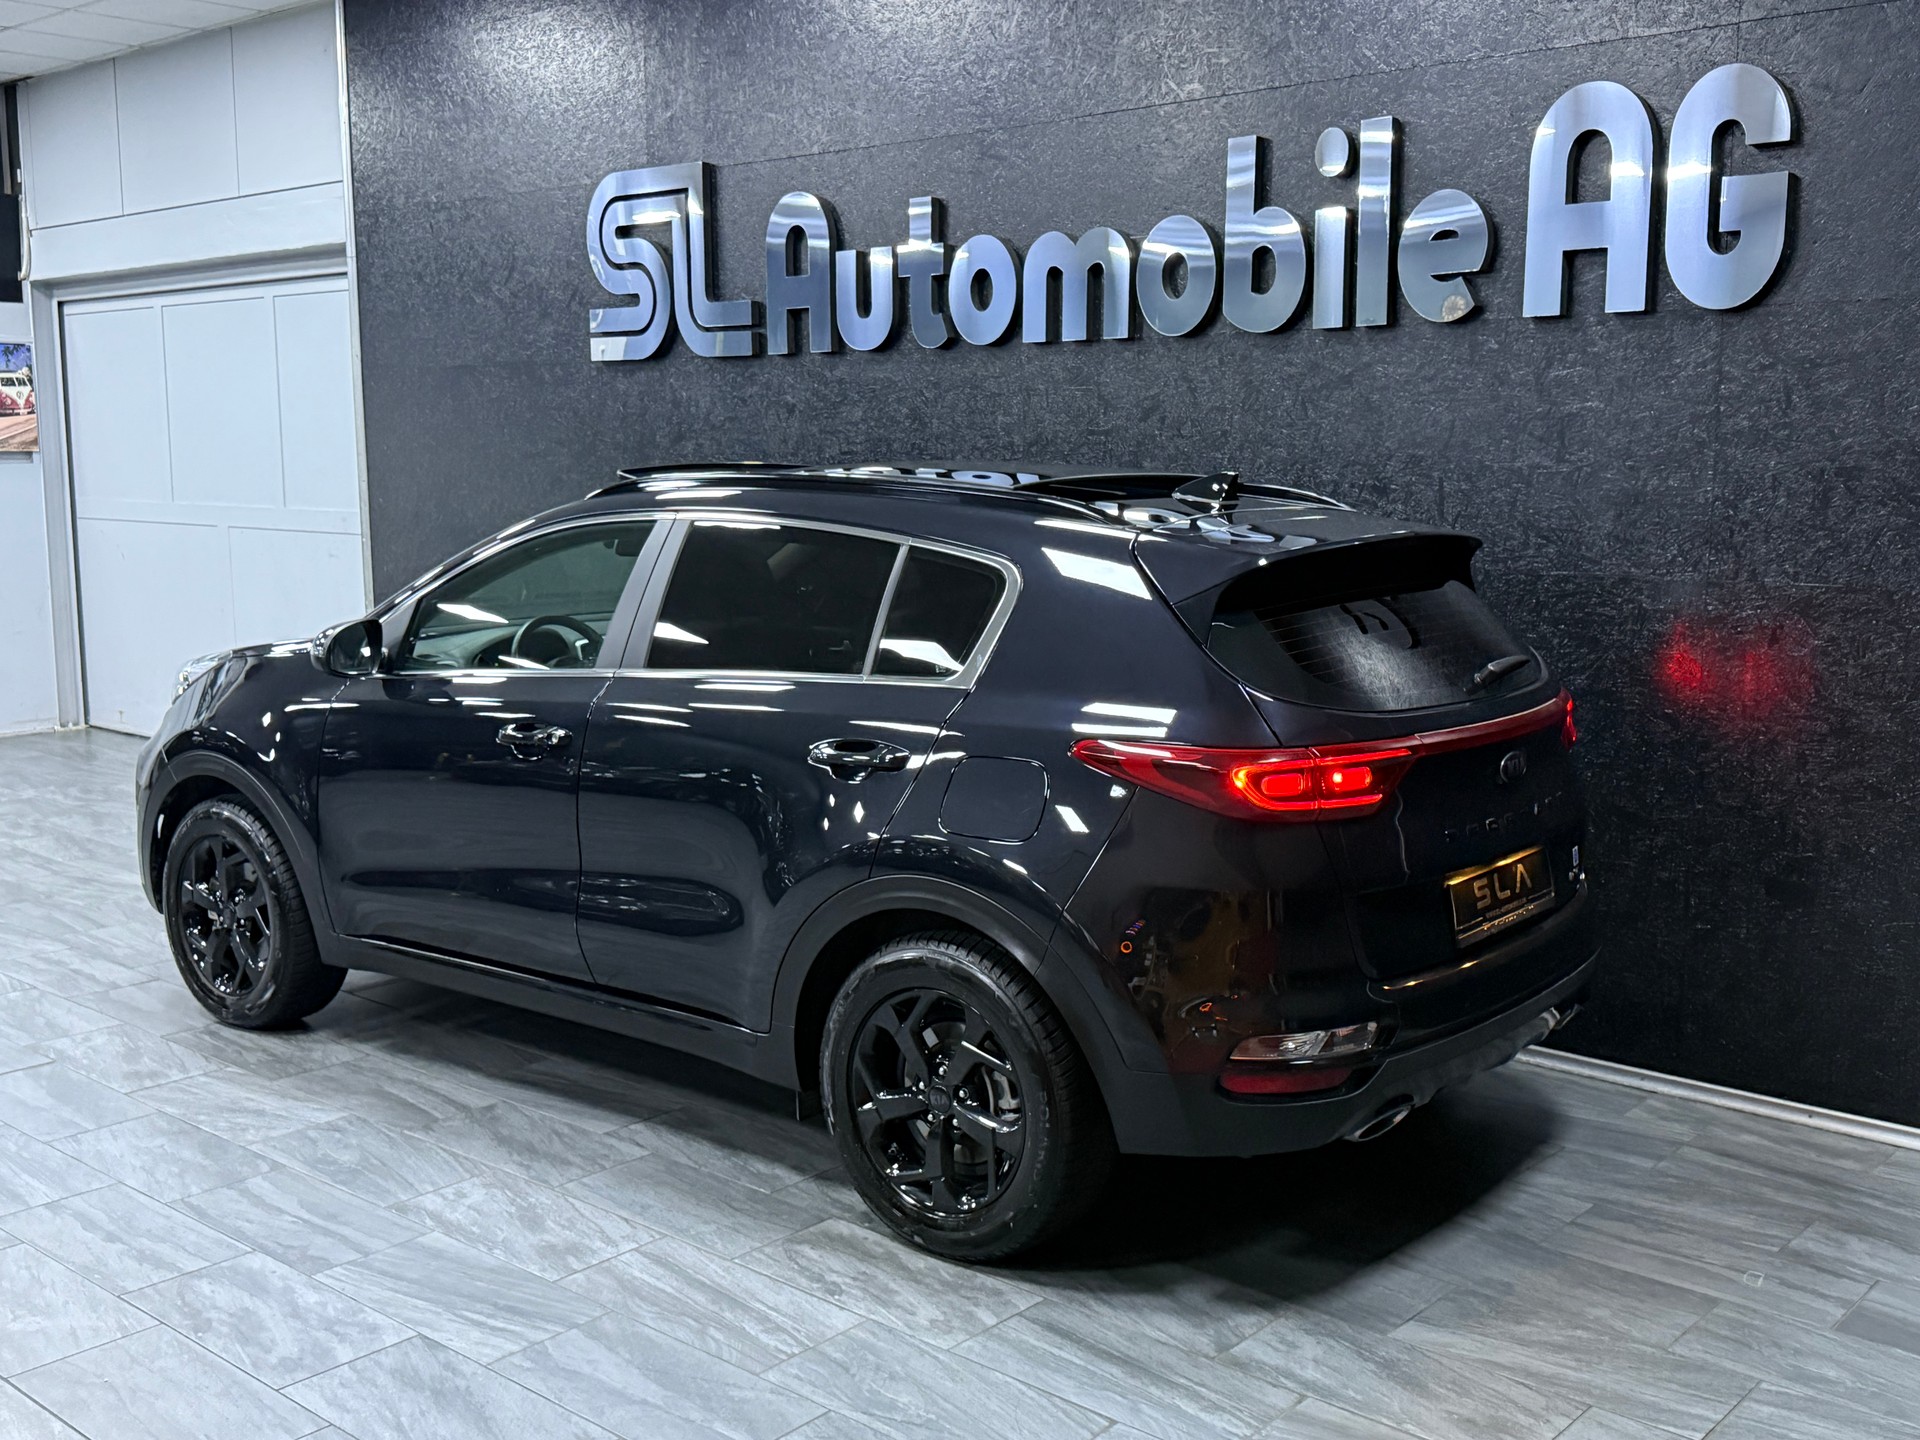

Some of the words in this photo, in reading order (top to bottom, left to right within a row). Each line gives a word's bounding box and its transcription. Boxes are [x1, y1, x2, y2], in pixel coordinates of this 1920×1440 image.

[586, 161, 754, 363] SL
[765, 114, 1490, 357] Automobile
[1522, 62, 1793, 319] AG
[1473, 863, 1533, 910] SLA
